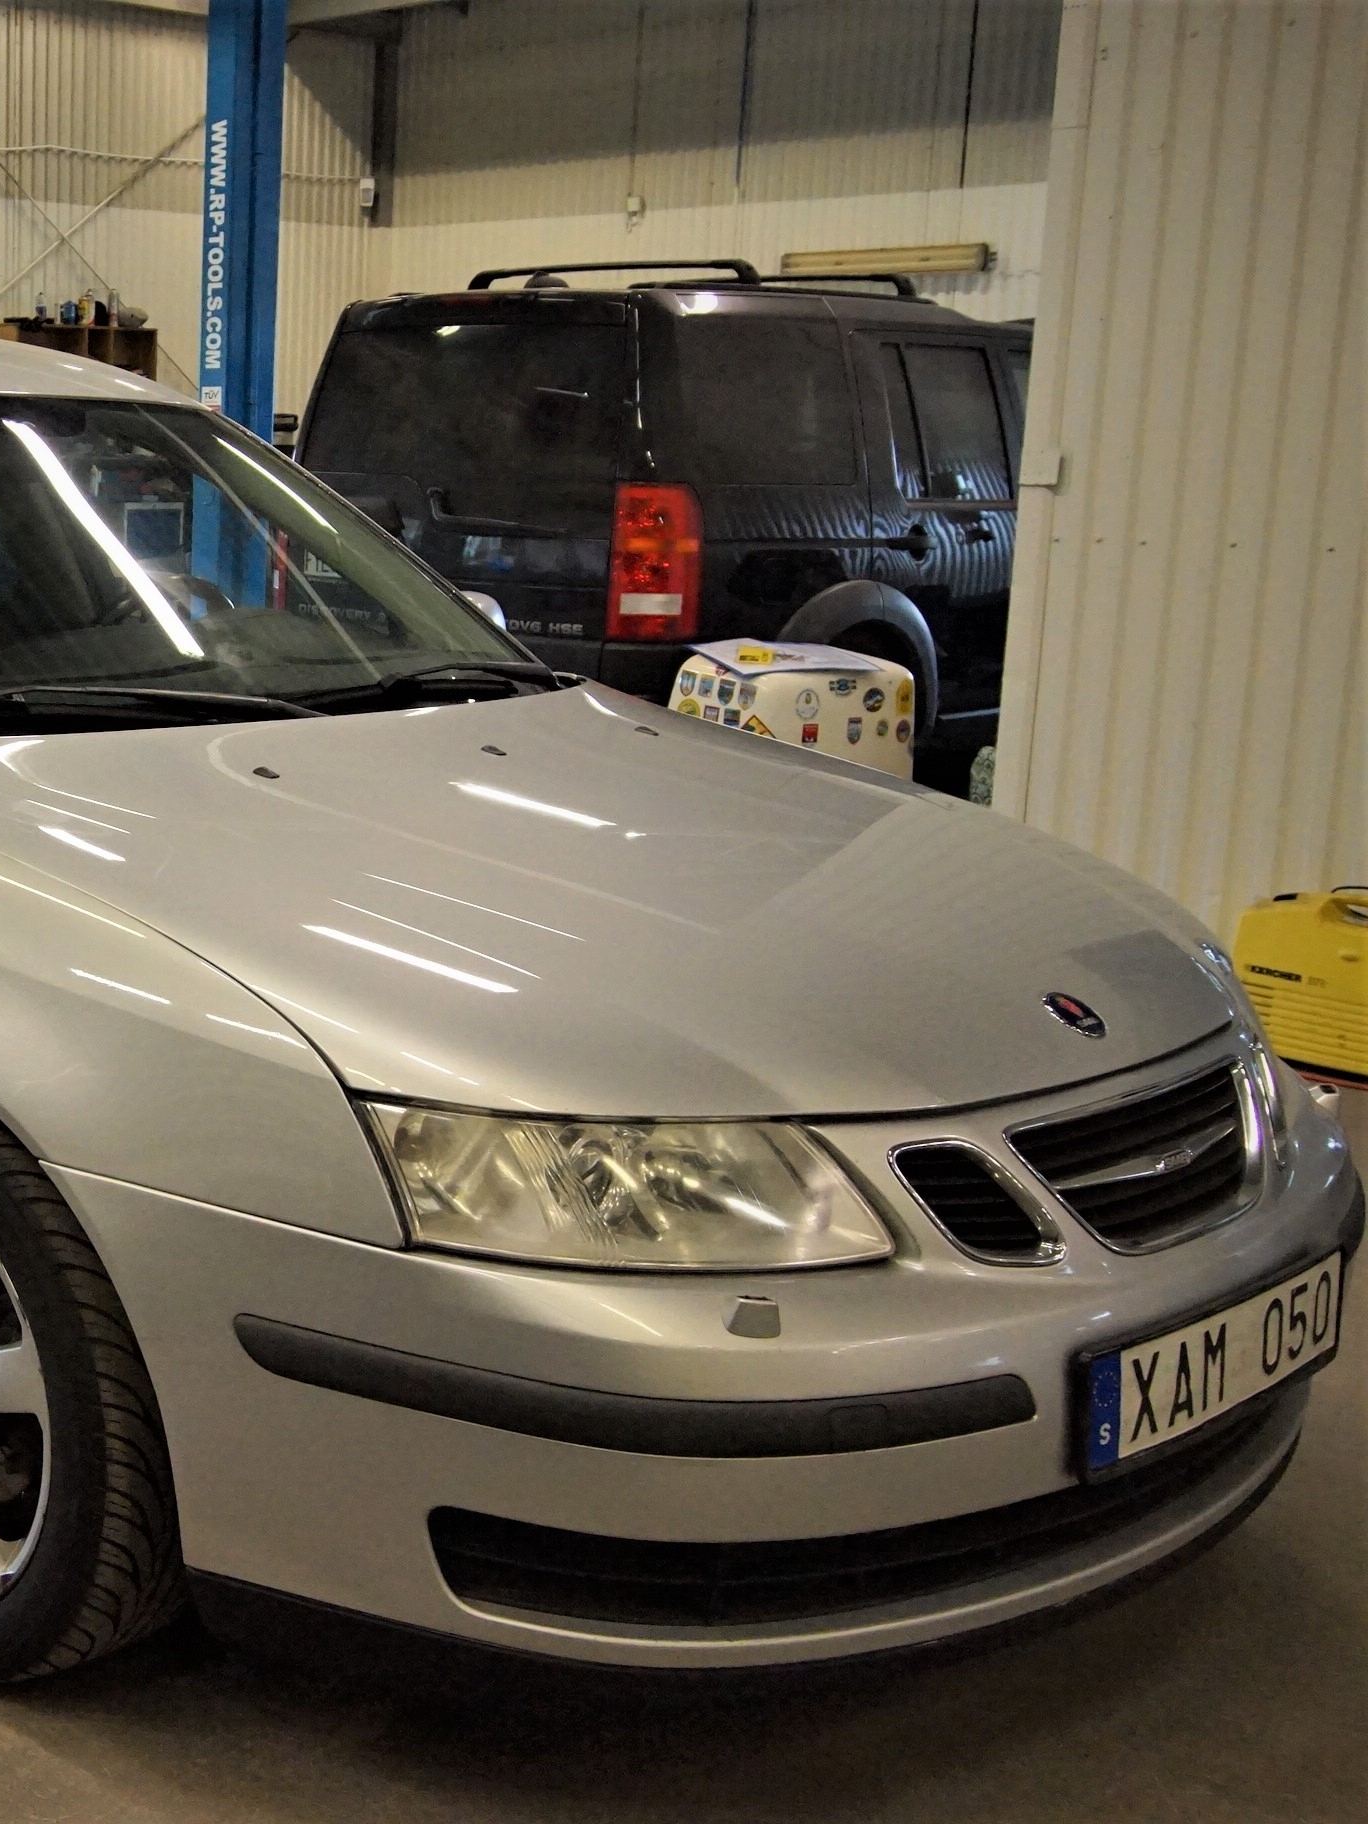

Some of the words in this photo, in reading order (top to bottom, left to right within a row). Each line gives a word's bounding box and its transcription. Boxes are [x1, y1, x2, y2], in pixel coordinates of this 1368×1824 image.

[205, 119, 228, 370] WWW.RP-TOOLS.COM
[548, 622, 584, 636] HSE
[1130, 1322, 1227, 1443] XAM
[1262, 1270, 1331, 1377] 050
[1099, 1423, 1111, 1446] S
